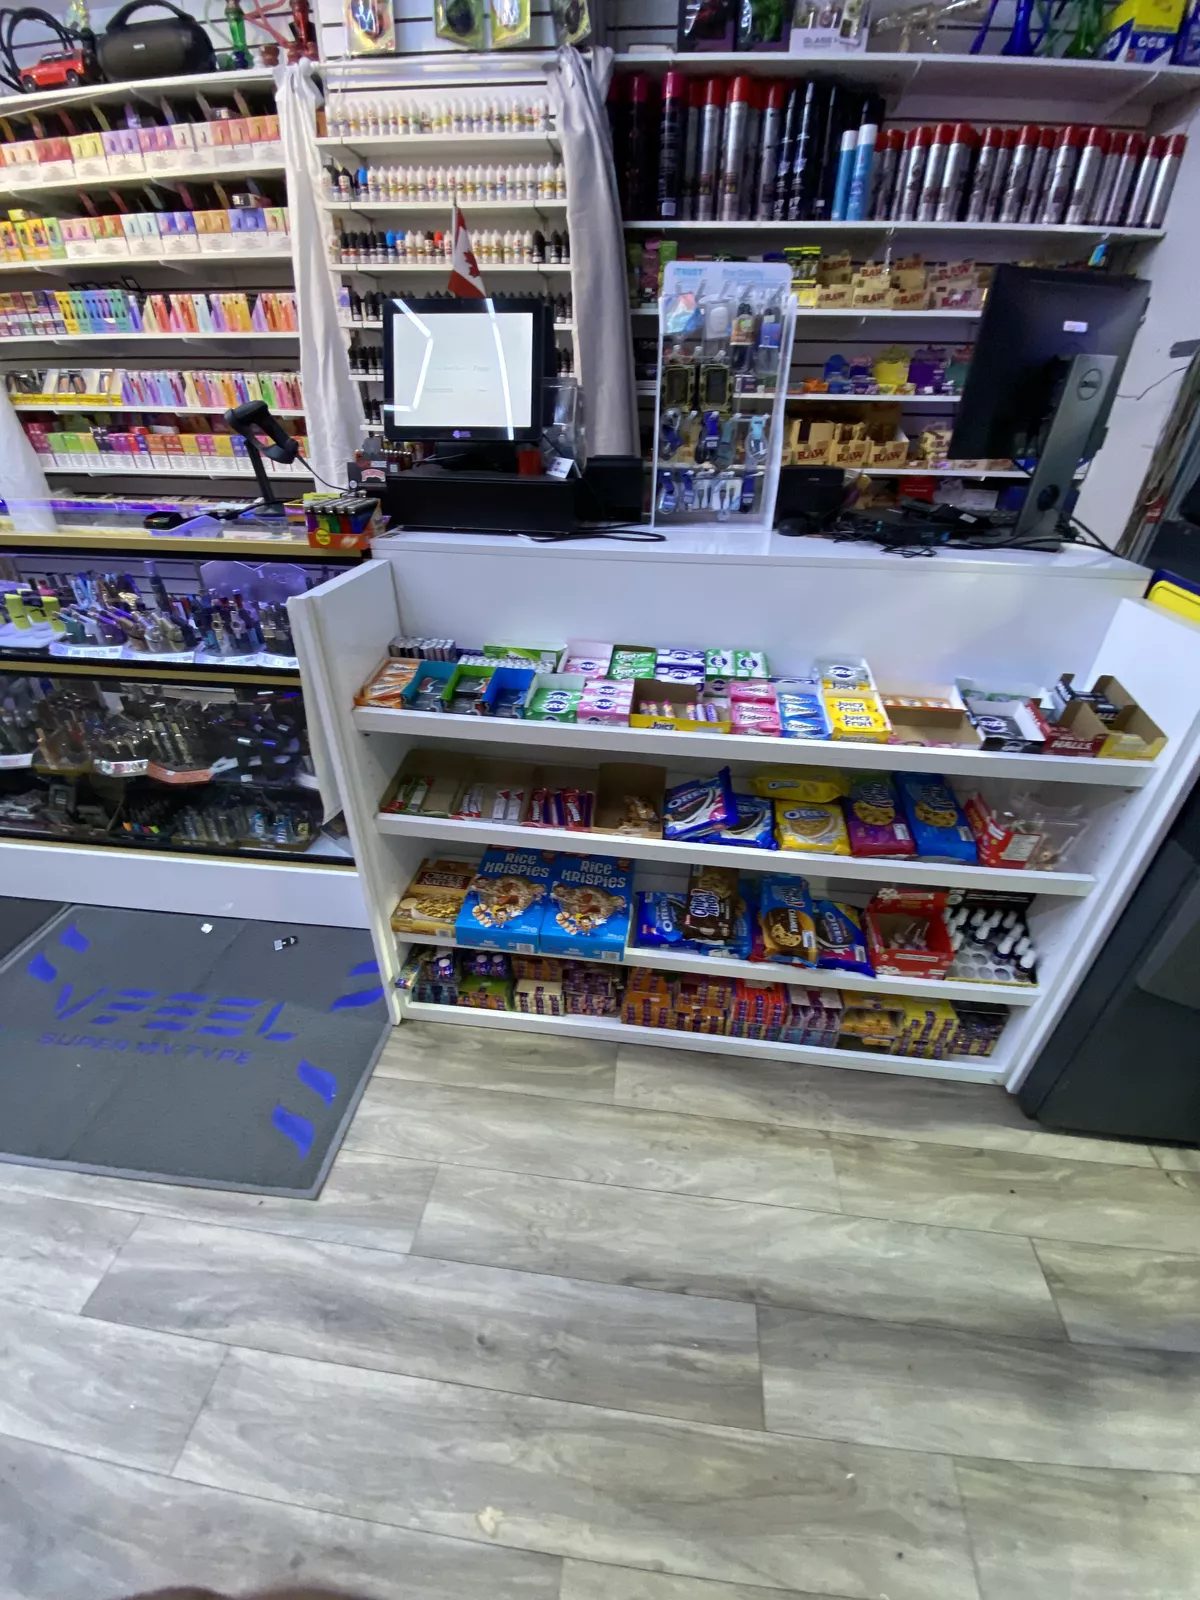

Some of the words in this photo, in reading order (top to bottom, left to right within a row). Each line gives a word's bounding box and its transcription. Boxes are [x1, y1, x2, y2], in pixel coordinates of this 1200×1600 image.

[1137, 36, 1167, 49] OCB
[825, 292, 846, 301] RAW
[862, 292, 885, 303] RAW
[900, 293, 924, 304] RAW
[797, 448, 826, 460] RAW
[837, 451, 865, 462] RAW
[873, 451, 902, 462] RAW
[615, 652, 652, 662] Dentyne
[612, 668, 650, 677] Dentyne
[543, 701, 569, 710] excel
[653, 721, 674, 730] Juicy
[786, 722, 820, 730] Trident
[1051, 740, 1093, 750] HALLS
[668, 787, 708, 808] OREO
[737, 804, 761, 813] REO
[784, 809, 830, 820] OREO
[504, 851, 537, 865] Rice
[580, 860, 613, 875] Rice
[690, 893, 708, 917] Chips
[661, 899, 673, 932] OREO
[825, 911, 843, 943] OREO
